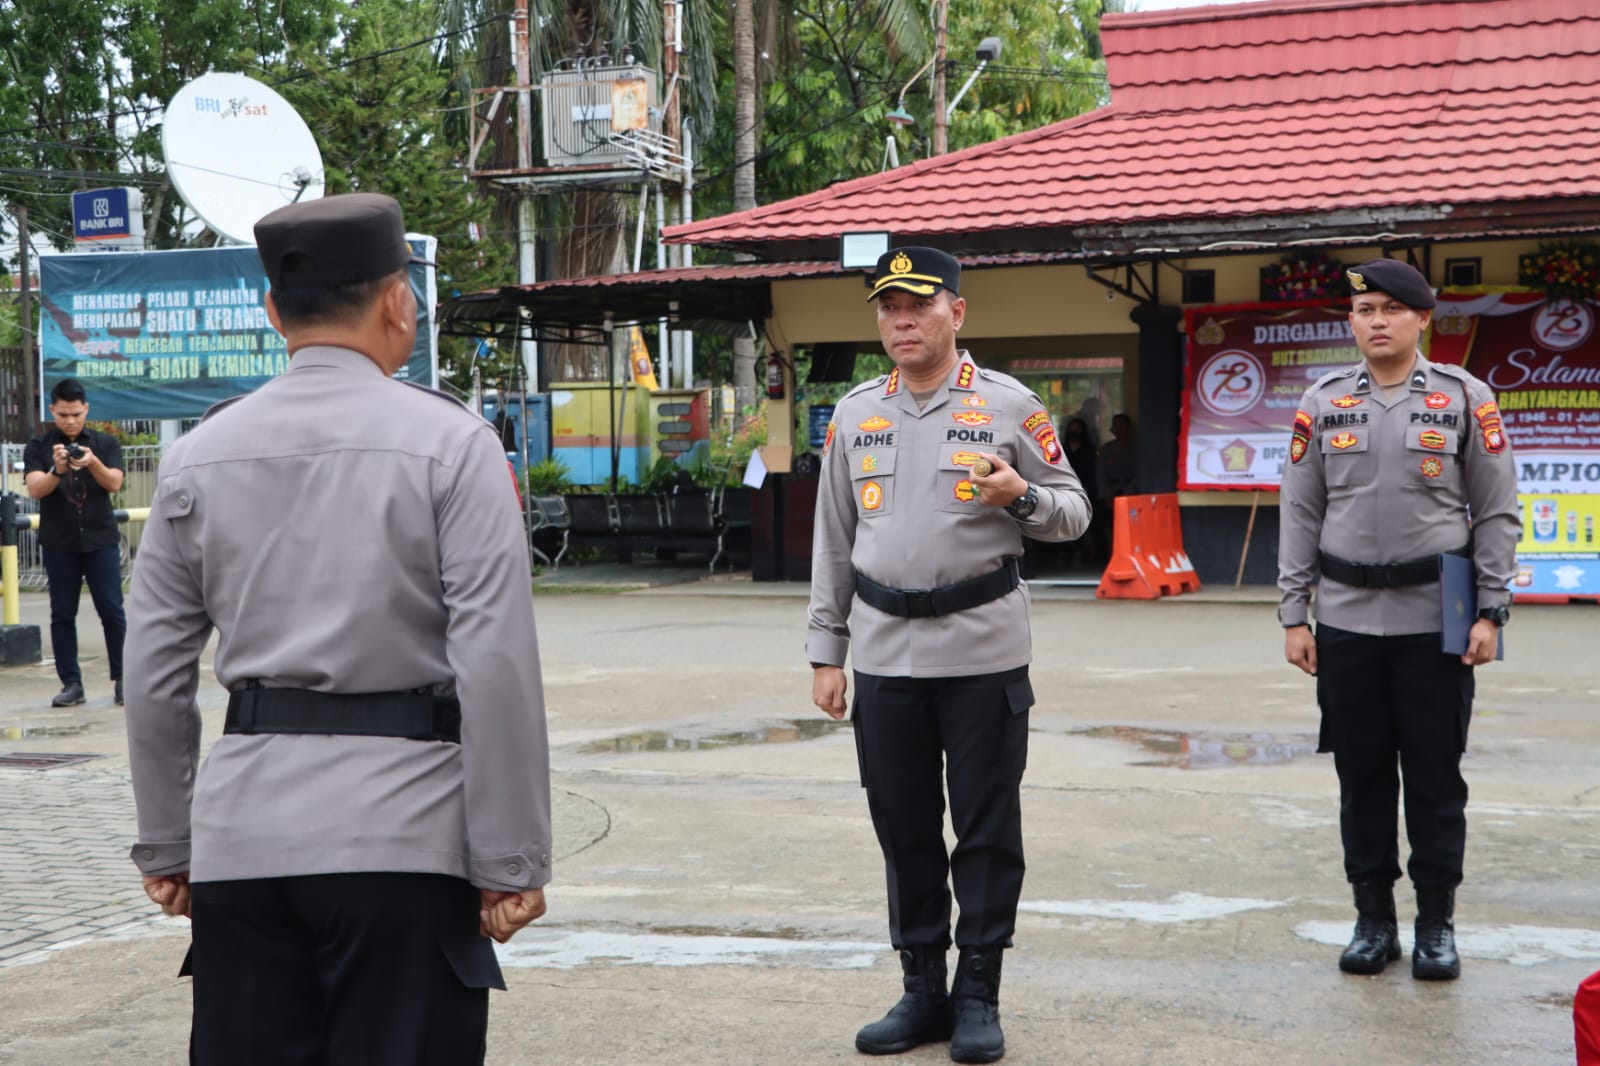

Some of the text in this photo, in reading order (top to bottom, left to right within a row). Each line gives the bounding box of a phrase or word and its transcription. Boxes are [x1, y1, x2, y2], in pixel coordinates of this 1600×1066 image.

[195, 97, 268, 116] BRI sat
[80, 217, 124, 231] BANK BRI
[73, 288, 259, 311] MENANGKAP PELAKU KEJAHATAN
[73, 311, 141, 329] MERUPAKAN
[147, 308, 196, 333] SUATU
[124, 337, 183, 354] MENCEGAH
[189, 334, 258, 353] TERJADINYA
[263, 333, 288, 351] KEJ
[76, 360, 144, 377] MERUPAKAN
[150, 356, 199, 380] SUATU
[1500, 390, 1600, 410] BHAYANGKAR
[1323, 412, 1368, 428] FARIS.S
[1410, 412, 1458, 427] POLRI
[853, 432, 894, 449] ADHE
[946, 429, 994, 444] POLRI
[1263, 447, 1286, 460] DPC
